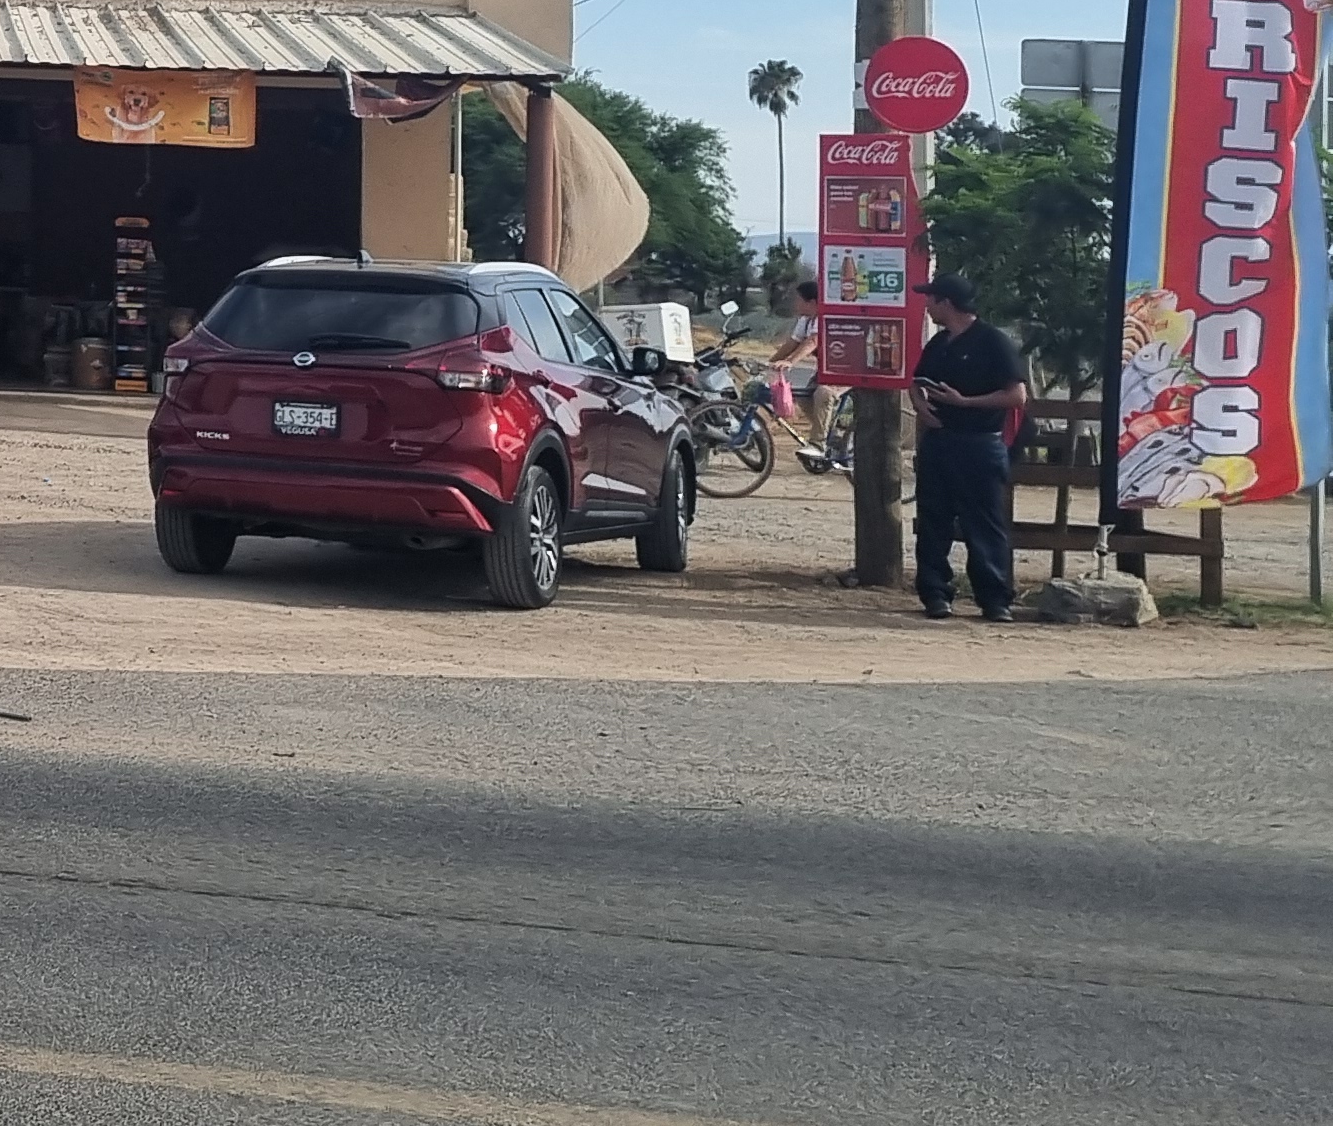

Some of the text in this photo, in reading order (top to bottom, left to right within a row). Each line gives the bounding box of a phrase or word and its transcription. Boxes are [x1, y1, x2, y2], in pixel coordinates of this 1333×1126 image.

[872, 71, 960, 98] Coca-Cola
[827, 140, 902, 165] Coca-Cola
[196, 431, 230, 440] KICKS
